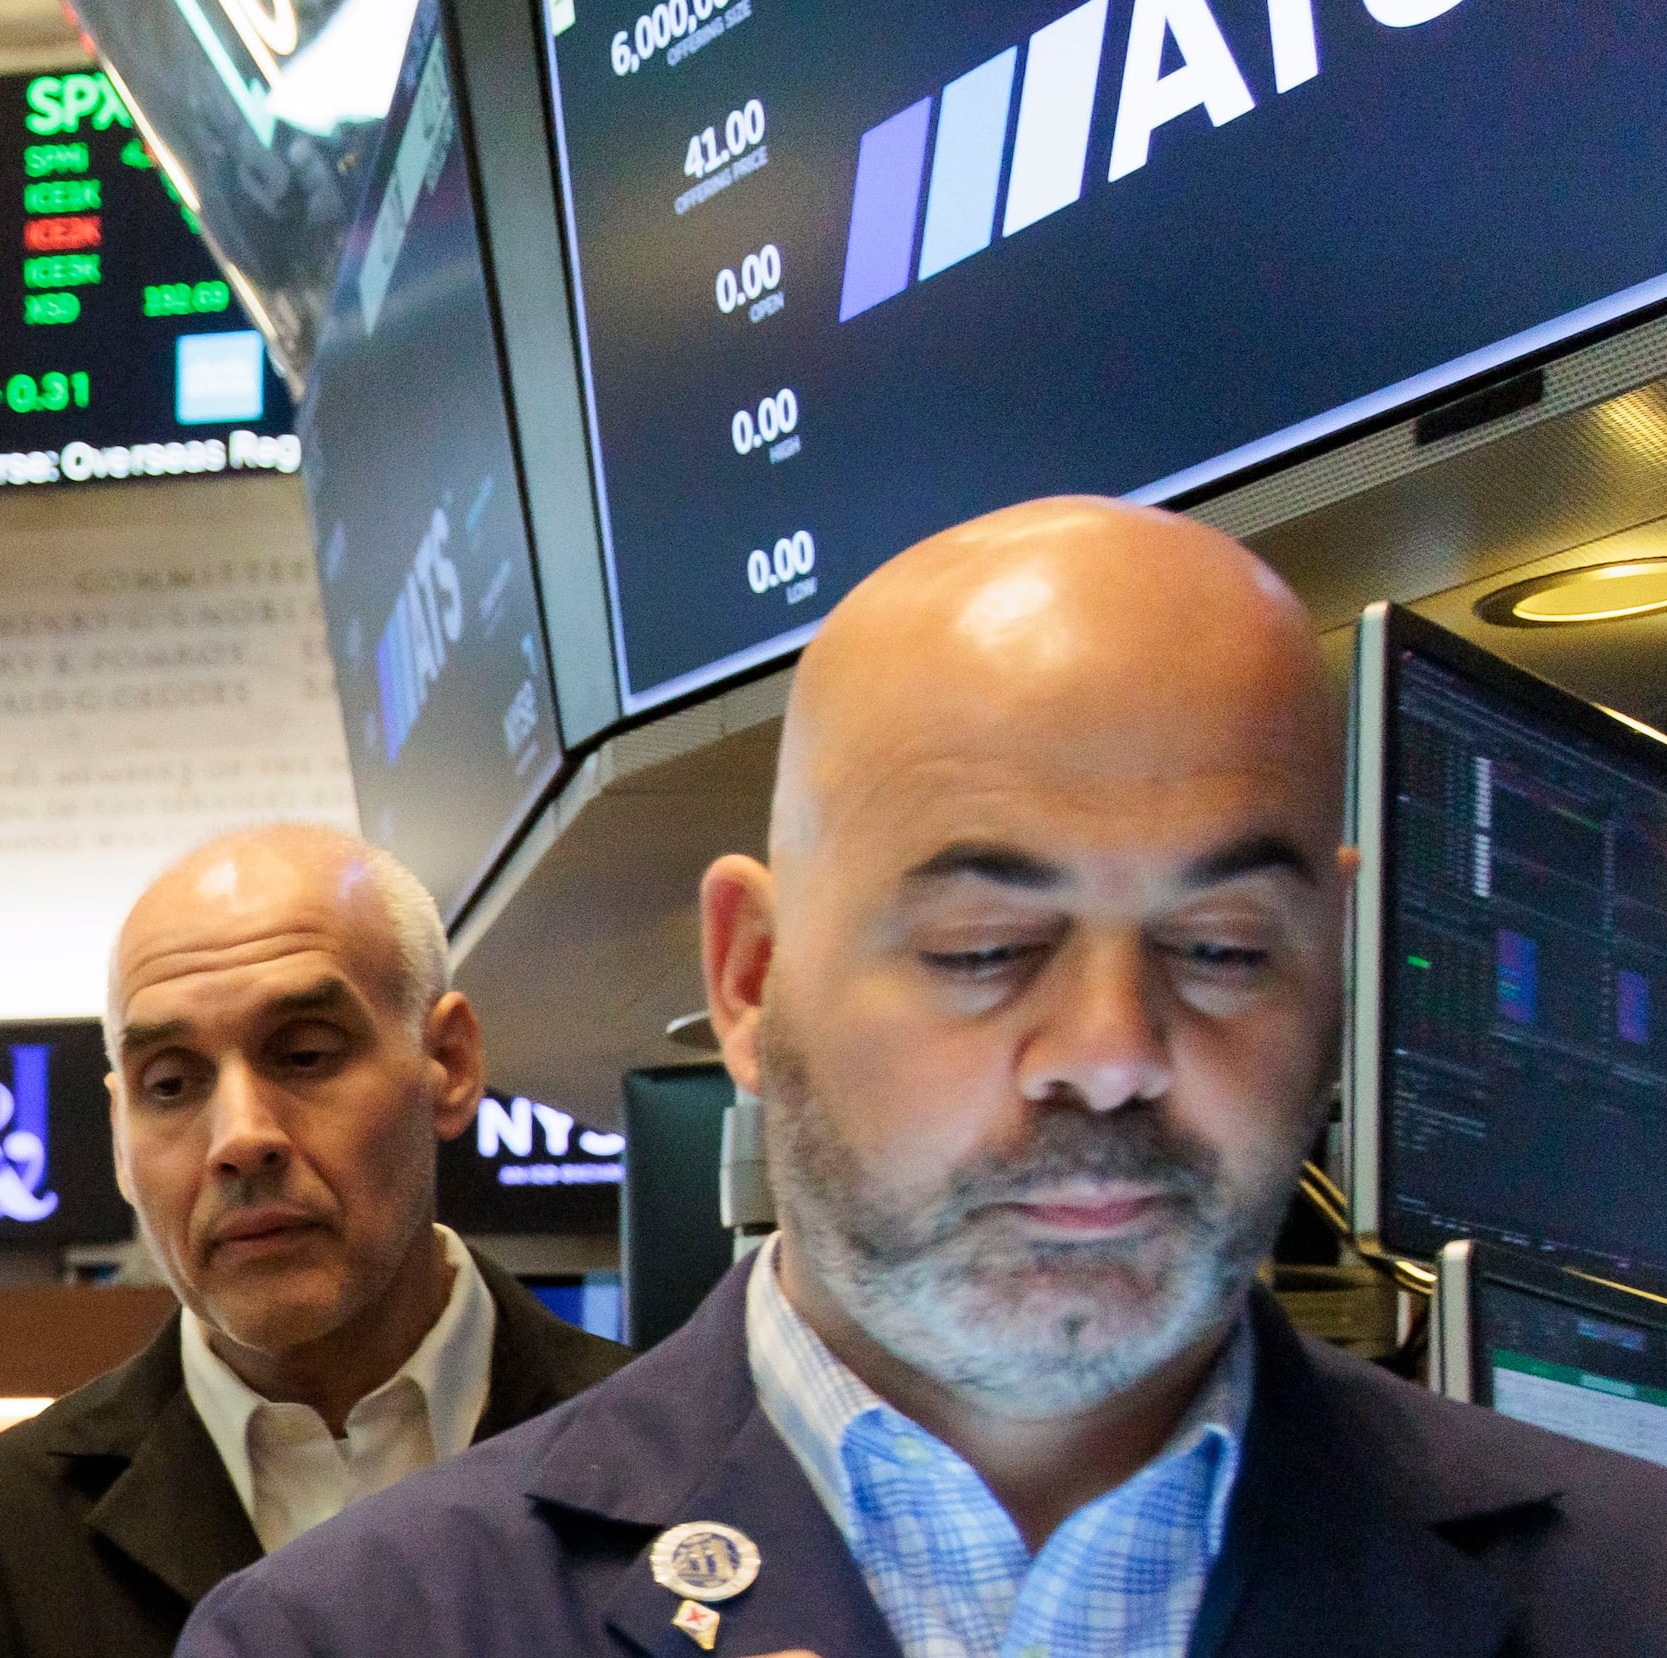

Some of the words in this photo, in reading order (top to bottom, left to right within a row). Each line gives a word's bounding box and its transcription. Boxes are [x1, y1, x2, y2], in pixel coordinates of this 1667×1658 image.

[684, 99, 765, 178] 41.00
[716, 244, 781, 313] 0.00
[748, 292, 785, 323] OPEN
[732, 388, 798, 455] 0.00
[60, 438, 226, 480] Overseas
[748, 530, 815, 594] 0.00
